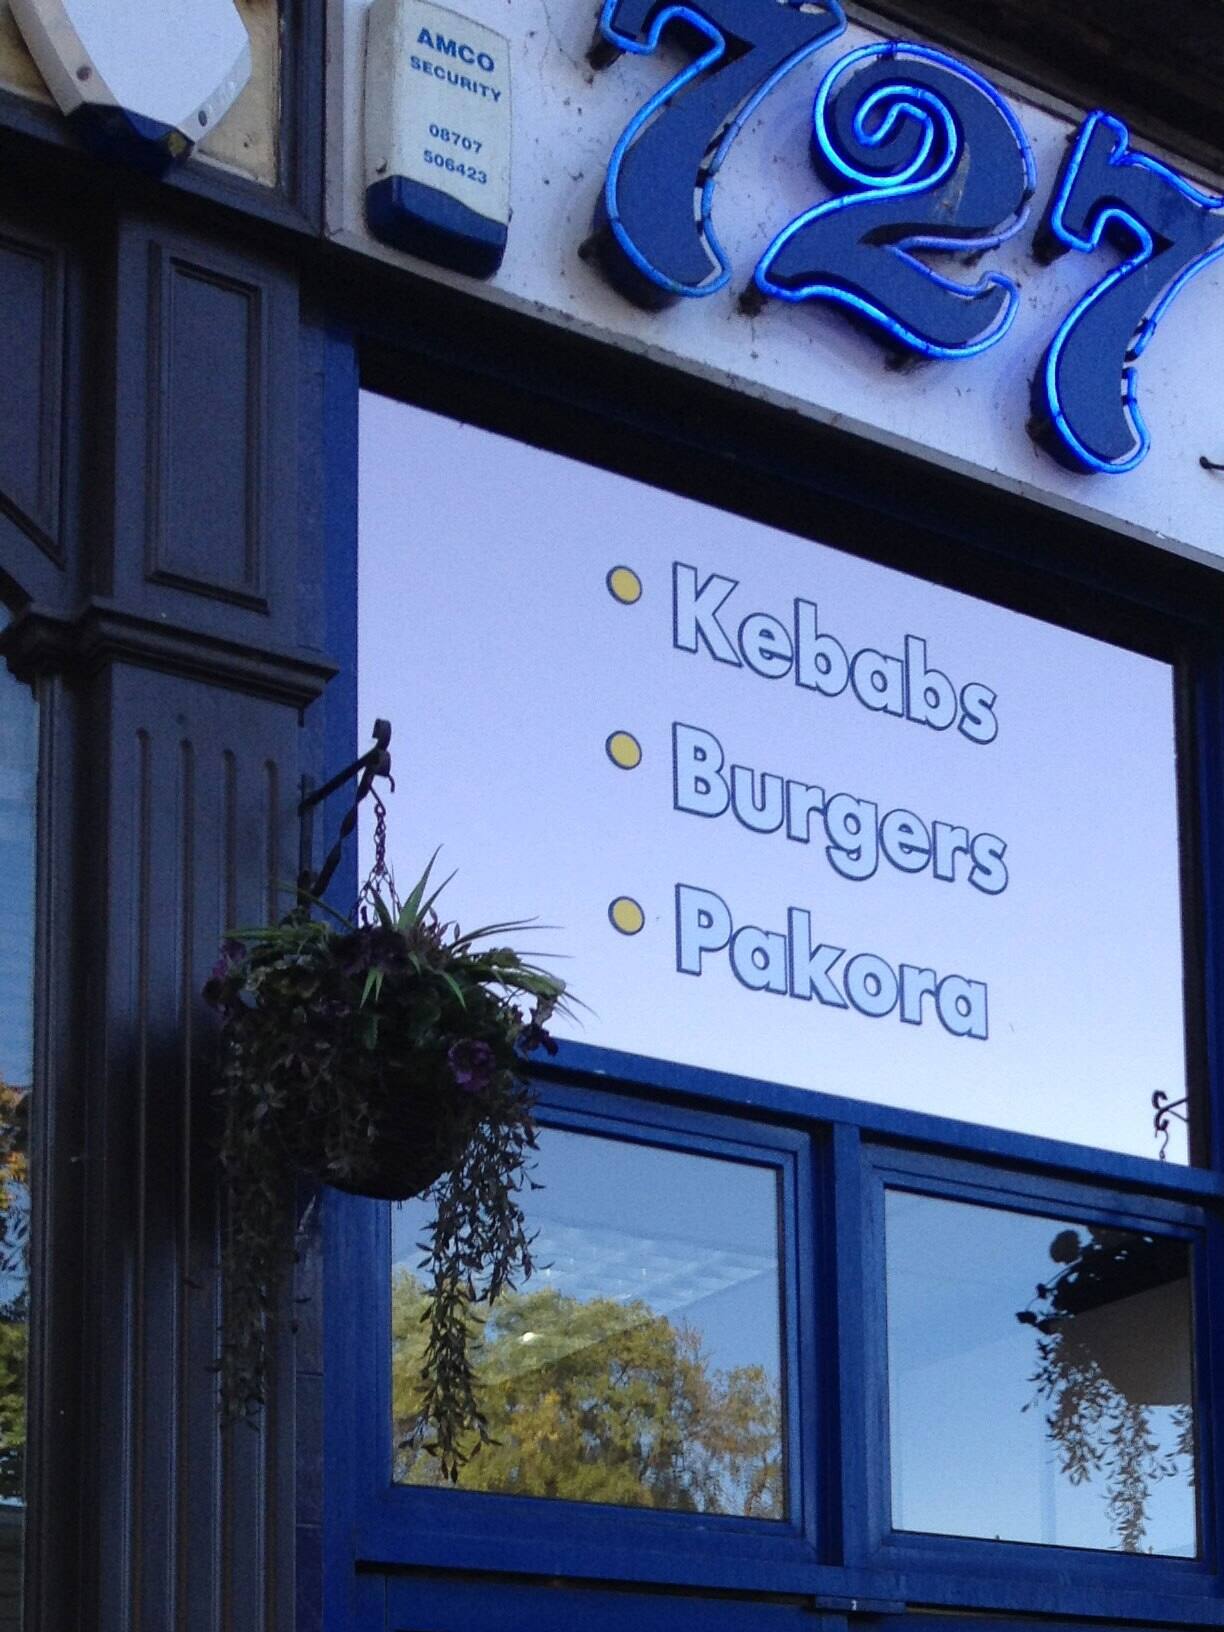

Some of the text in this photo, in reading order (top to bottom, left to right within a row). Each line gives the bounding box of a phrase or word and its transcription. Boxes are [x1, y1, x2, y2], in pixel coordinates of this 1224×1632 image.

[416, 27, 495, 73] AMCO
[410, 55, 502, 103] SECURITY
[428, 123, 483, 154] 08707
[423, 149, 488, 185] 506423
[672, 561, 998, 745] Kebabs
[672, 722, 1009, 895] Burgers
[674, 883, 989, 1041] Pakora
